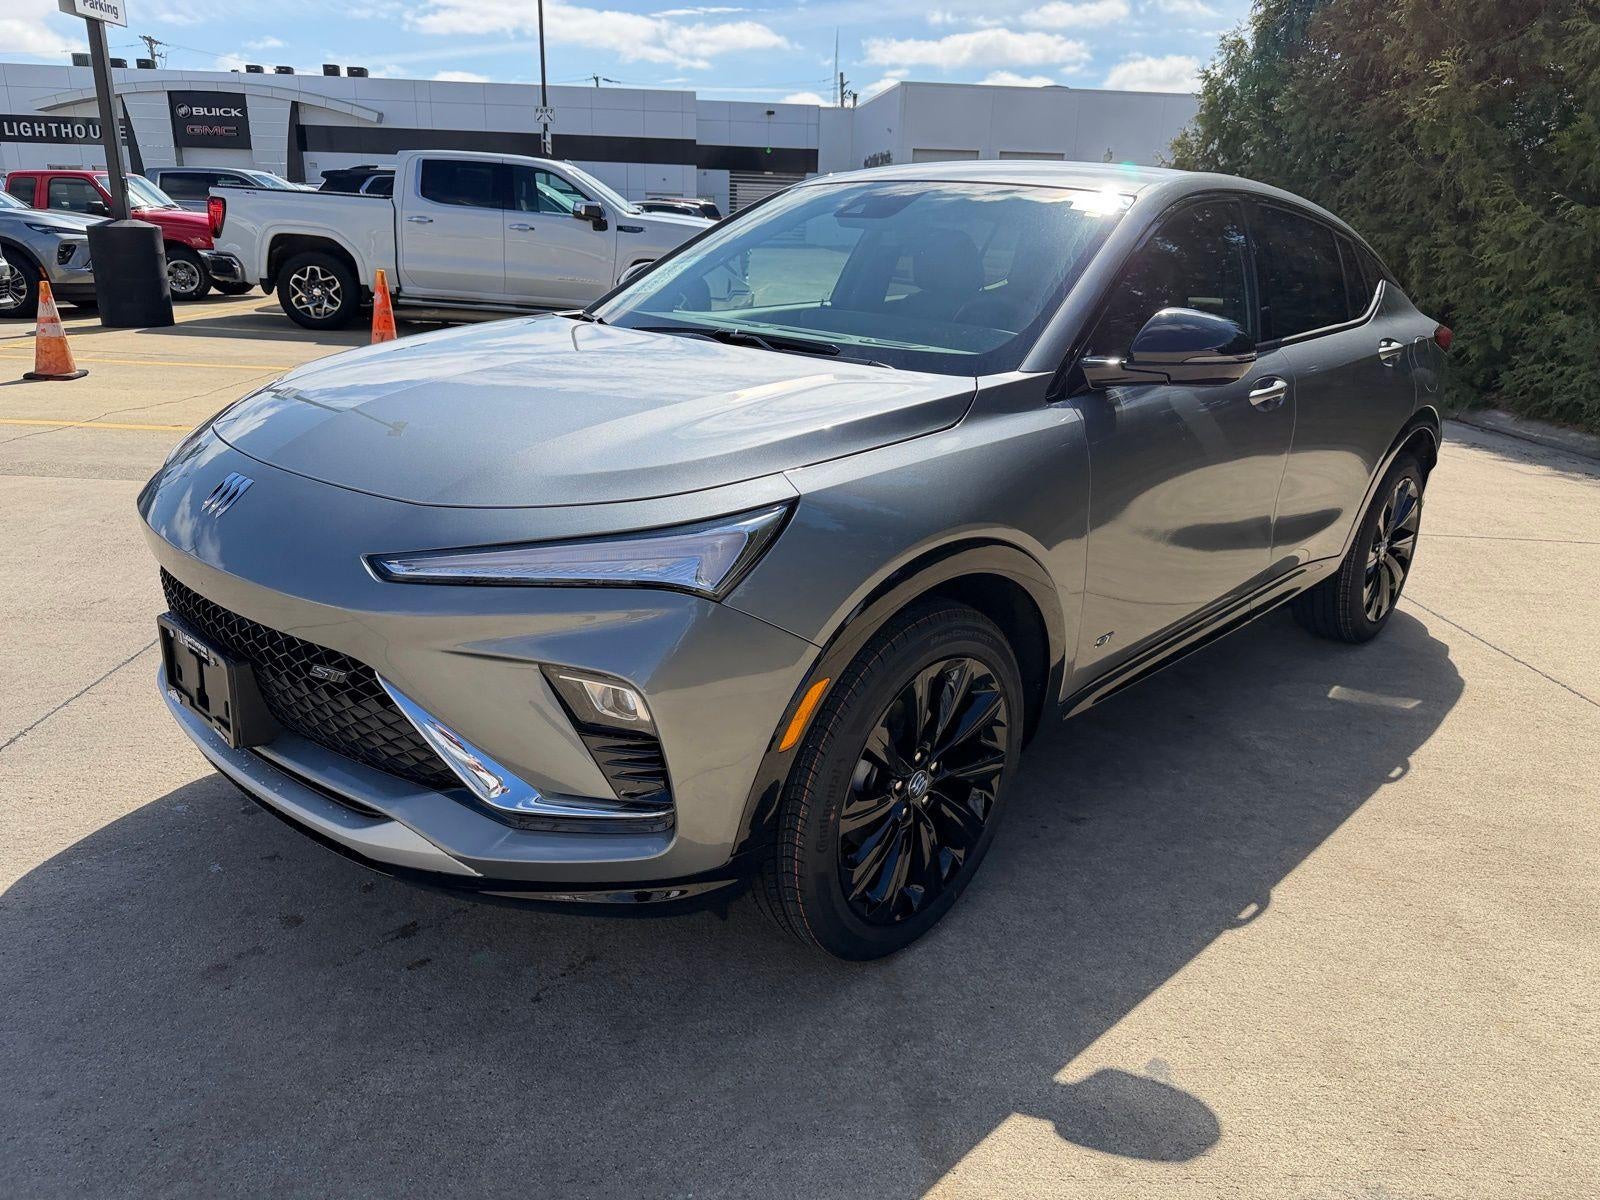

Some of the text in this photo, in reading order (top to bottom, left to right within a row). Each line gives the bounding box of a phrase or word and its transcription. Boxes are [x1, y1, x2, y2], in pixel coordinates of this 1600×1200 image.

[83, 0, 119, 20] Parking
[191, 106, 244, 117] BUICK
[3, 121, 128, 140] LIGHTHOUE
[186, 124, 238, 136] GMC
[309, 663, 348, 684] ST
